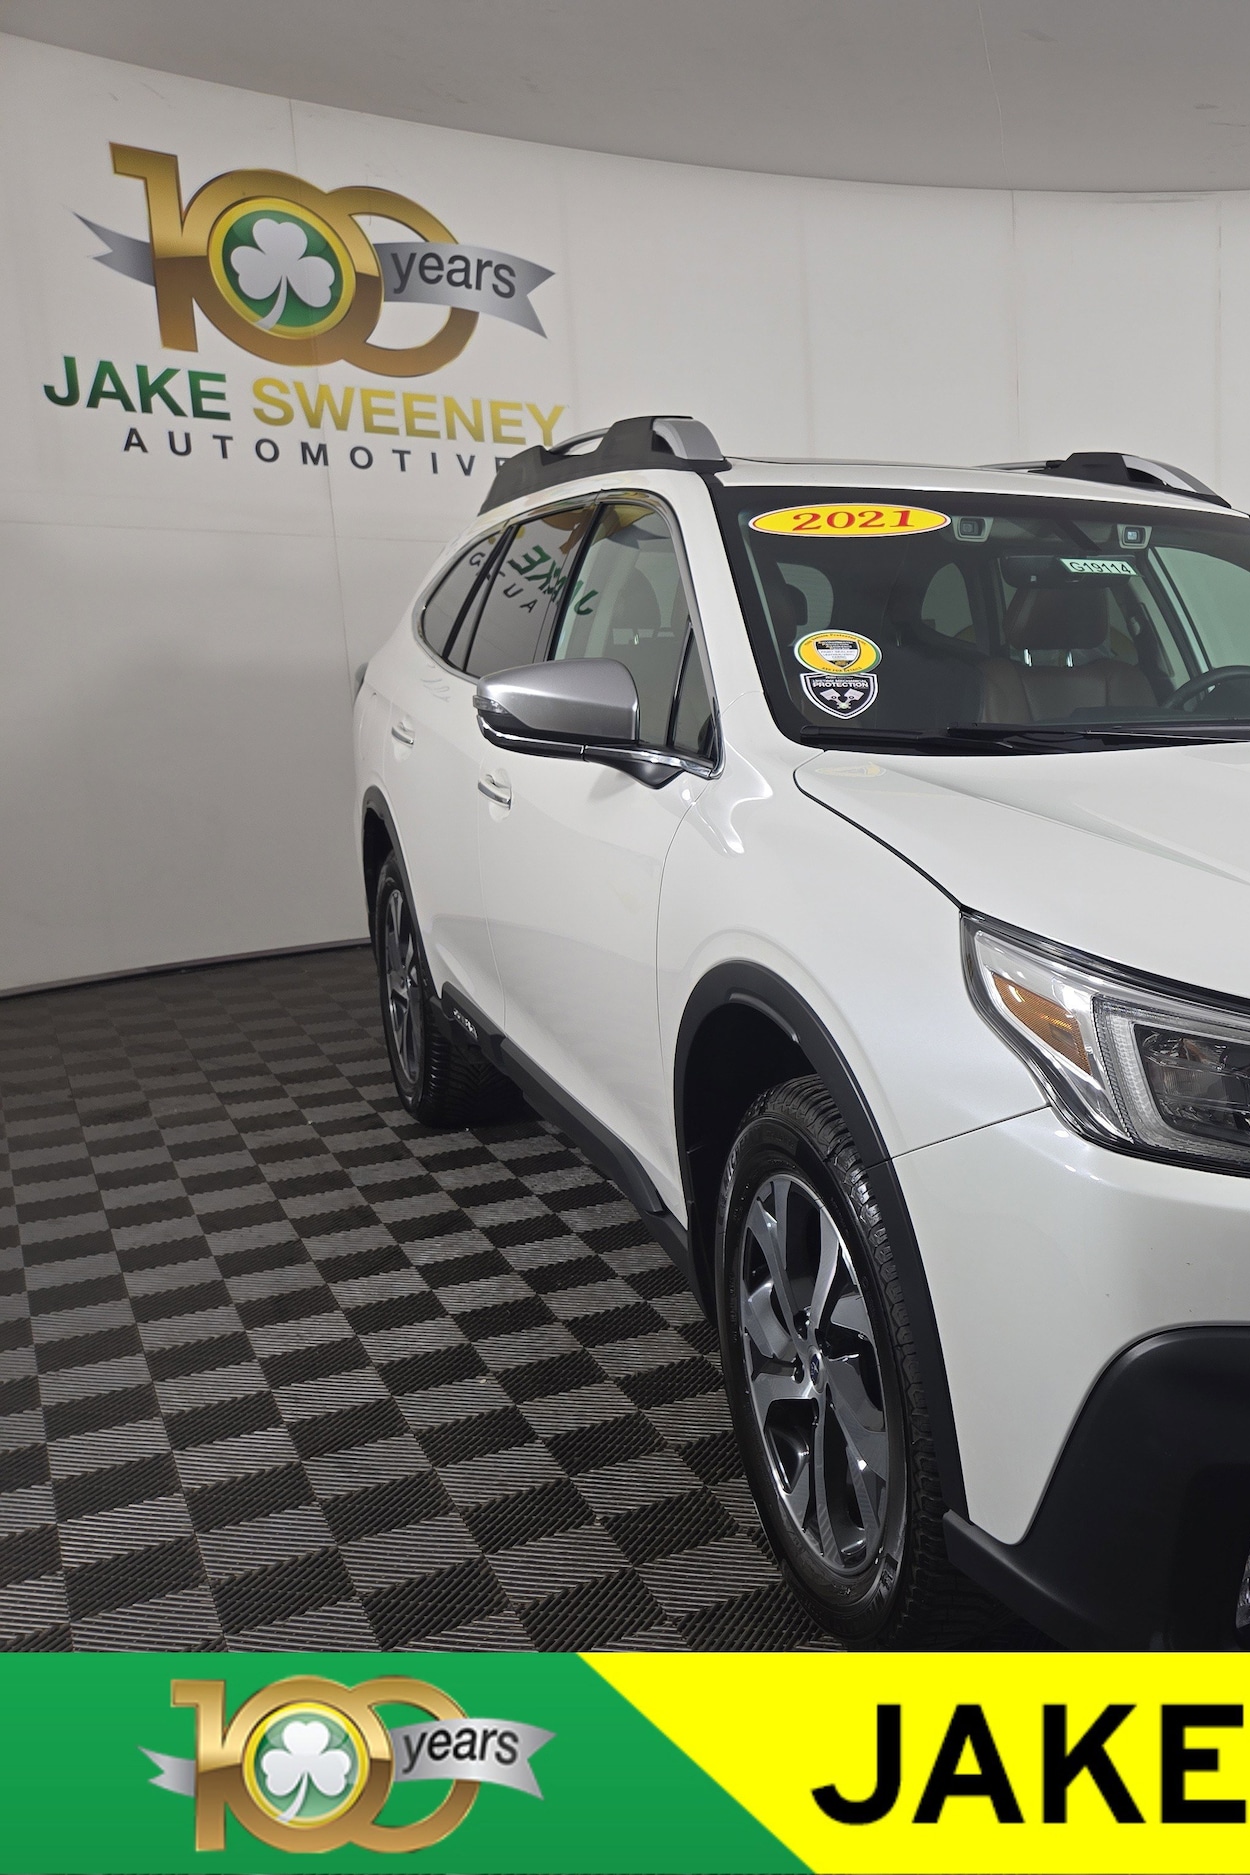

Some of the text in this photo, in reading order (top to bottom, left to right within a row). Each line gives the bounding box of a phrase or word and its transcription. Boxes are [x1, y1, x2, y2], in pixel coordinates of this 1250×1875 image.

[391, 250, 516, 299] years
[43, 355, 565, 447] JAKE SWEENEY
[792, 509, 915, 533] 2021
[1069, 562, 1131, 575] G19114
